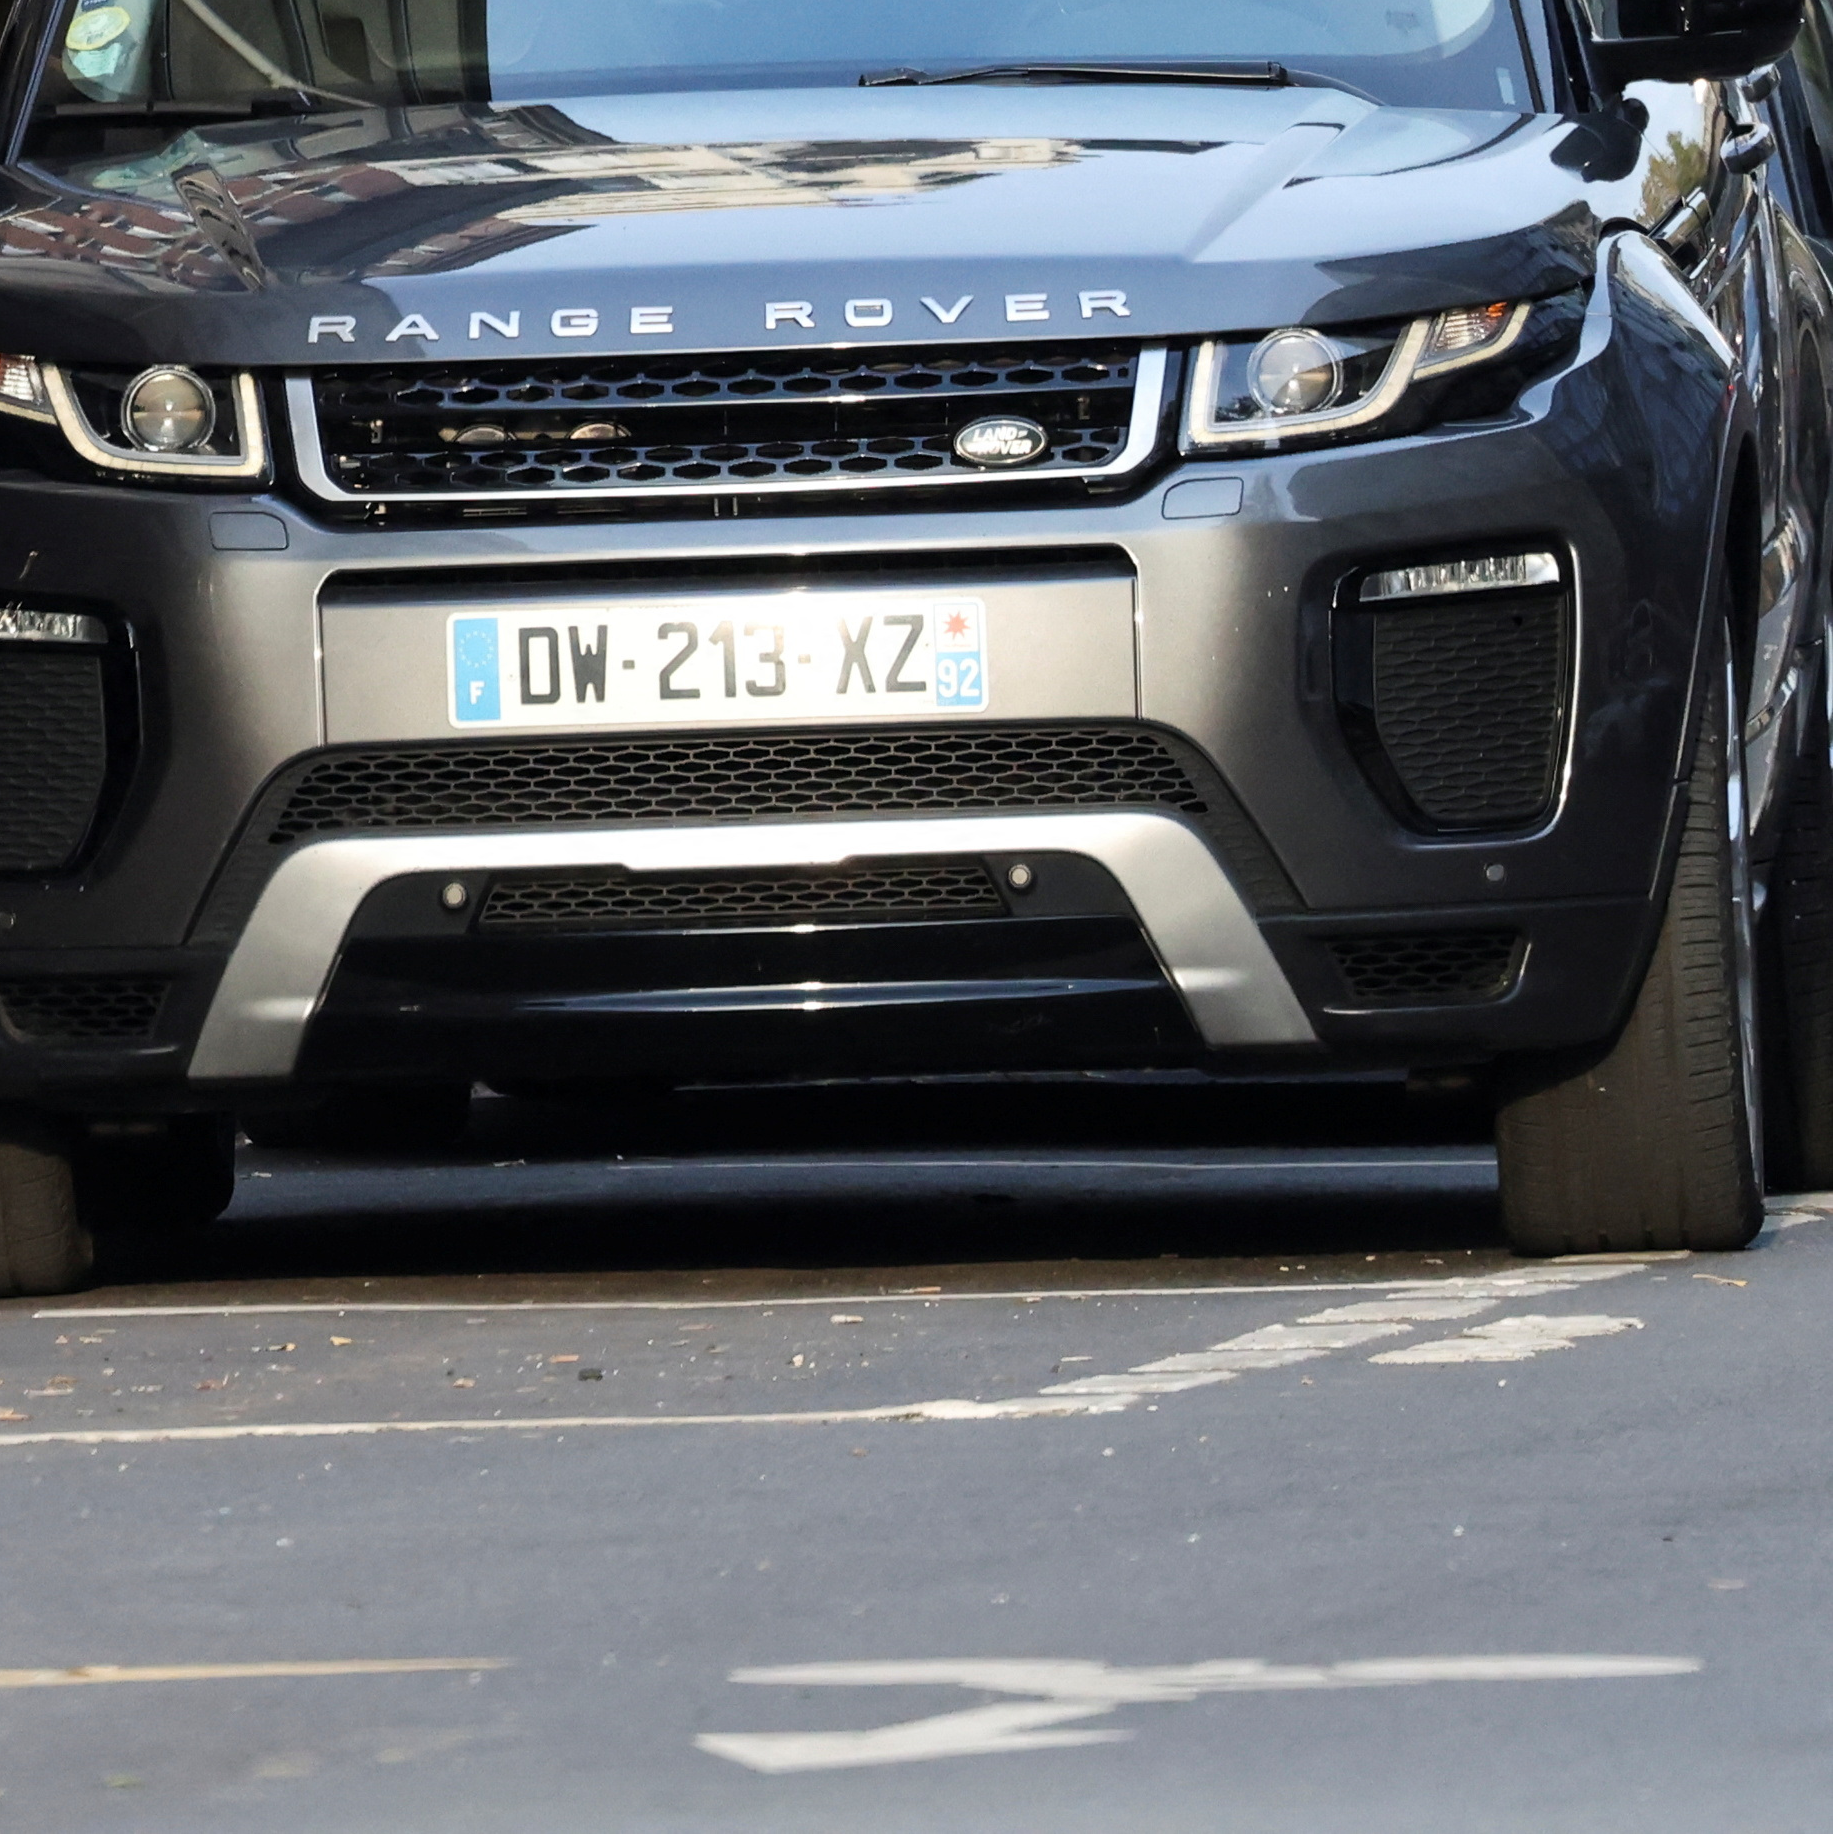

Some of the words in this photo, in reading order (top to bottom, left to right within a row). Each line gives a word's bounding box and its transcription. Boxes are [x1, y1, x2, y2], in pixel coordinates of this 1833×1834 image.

[307, 305, 675, 345] RANGE
[763, 288, 1132, 332] ROVER
[967, 438, 1034, 457] ROVER
[972, 425, 1019, 443] LAND
[518, 613, 928, 706] DW-213-XZ
[468, 679, 486, 705] F
[936, 657, 981, 699] 92
